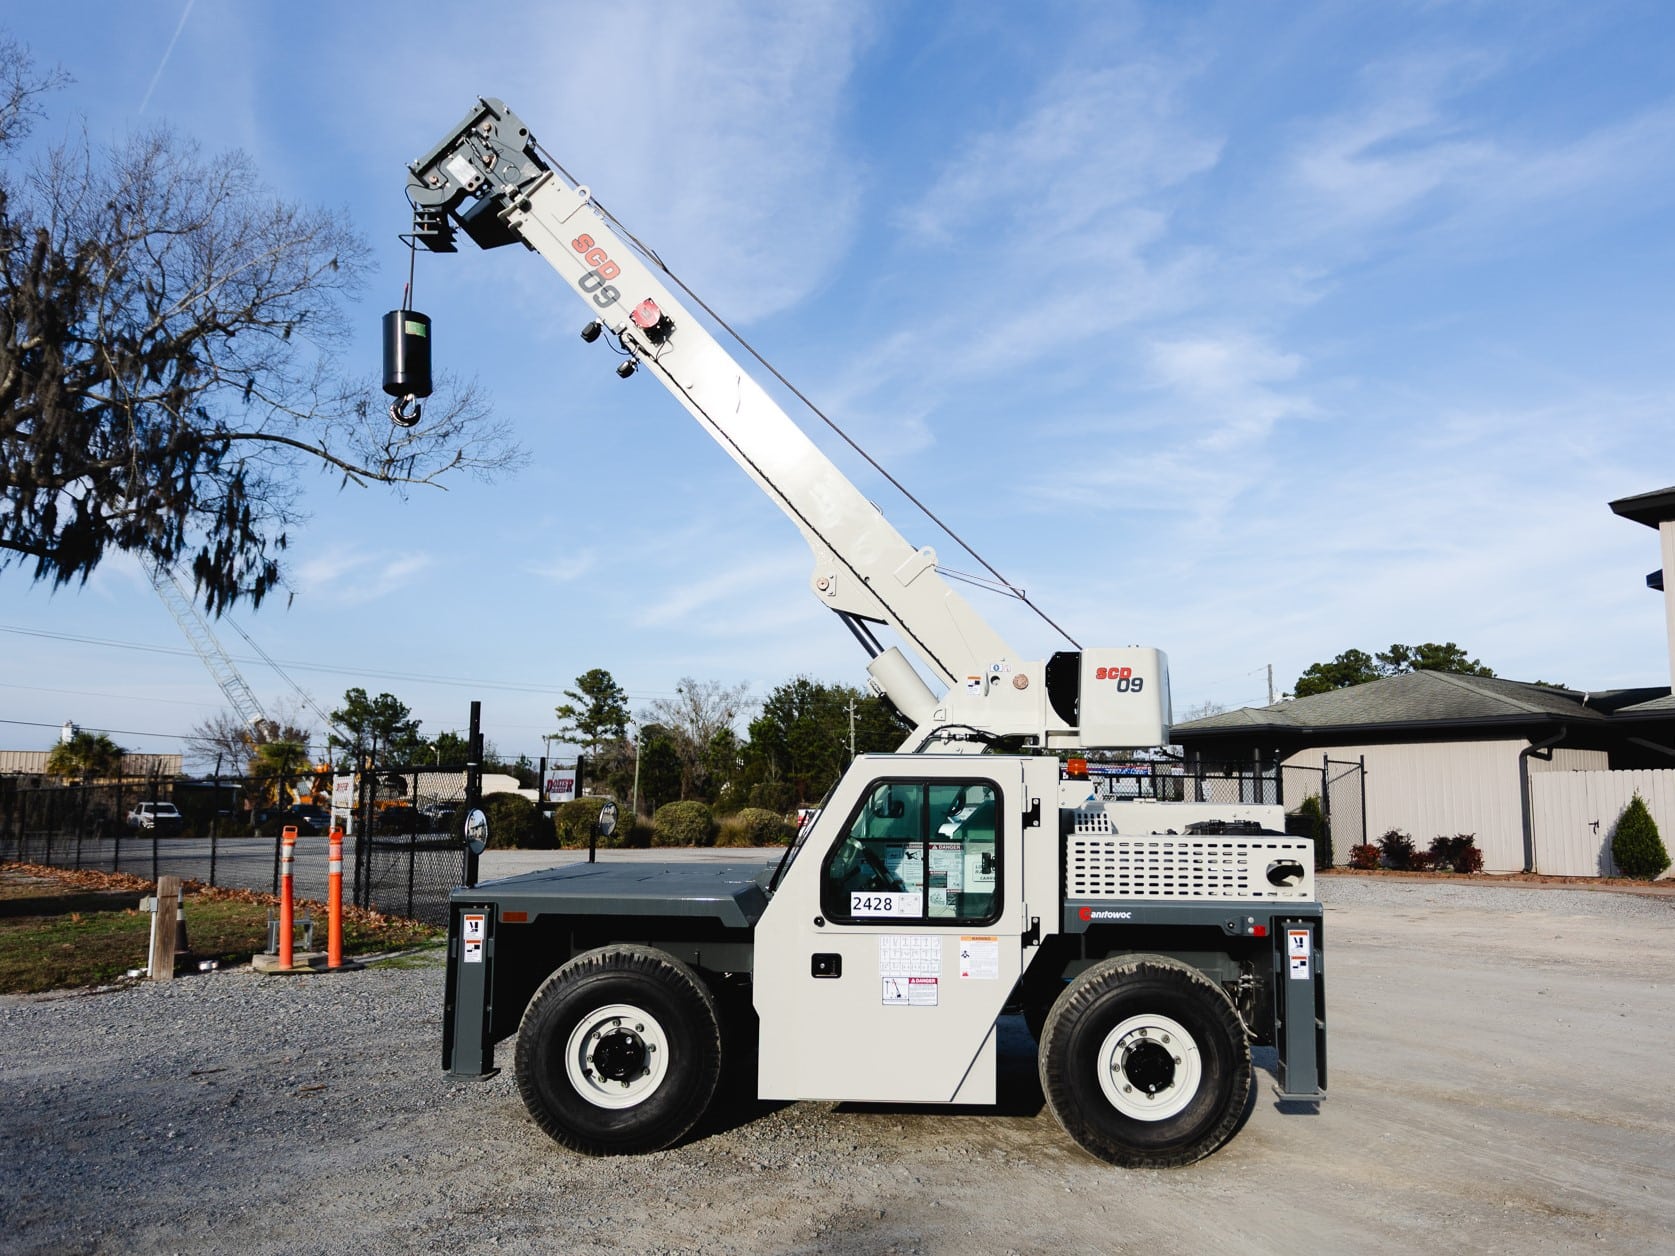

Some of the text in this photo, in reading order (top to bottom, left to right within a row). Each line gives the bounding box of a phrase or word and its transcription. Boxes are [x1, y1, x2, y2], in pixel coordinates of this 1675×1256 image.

[571, 233, 621, 280] SCD
[578, 270, 621, 308] 09
[1096, 667, 1132, 680] SCD
[1116, 677, 1144, 692] 09
[853, 896, 892, 911] 2428
